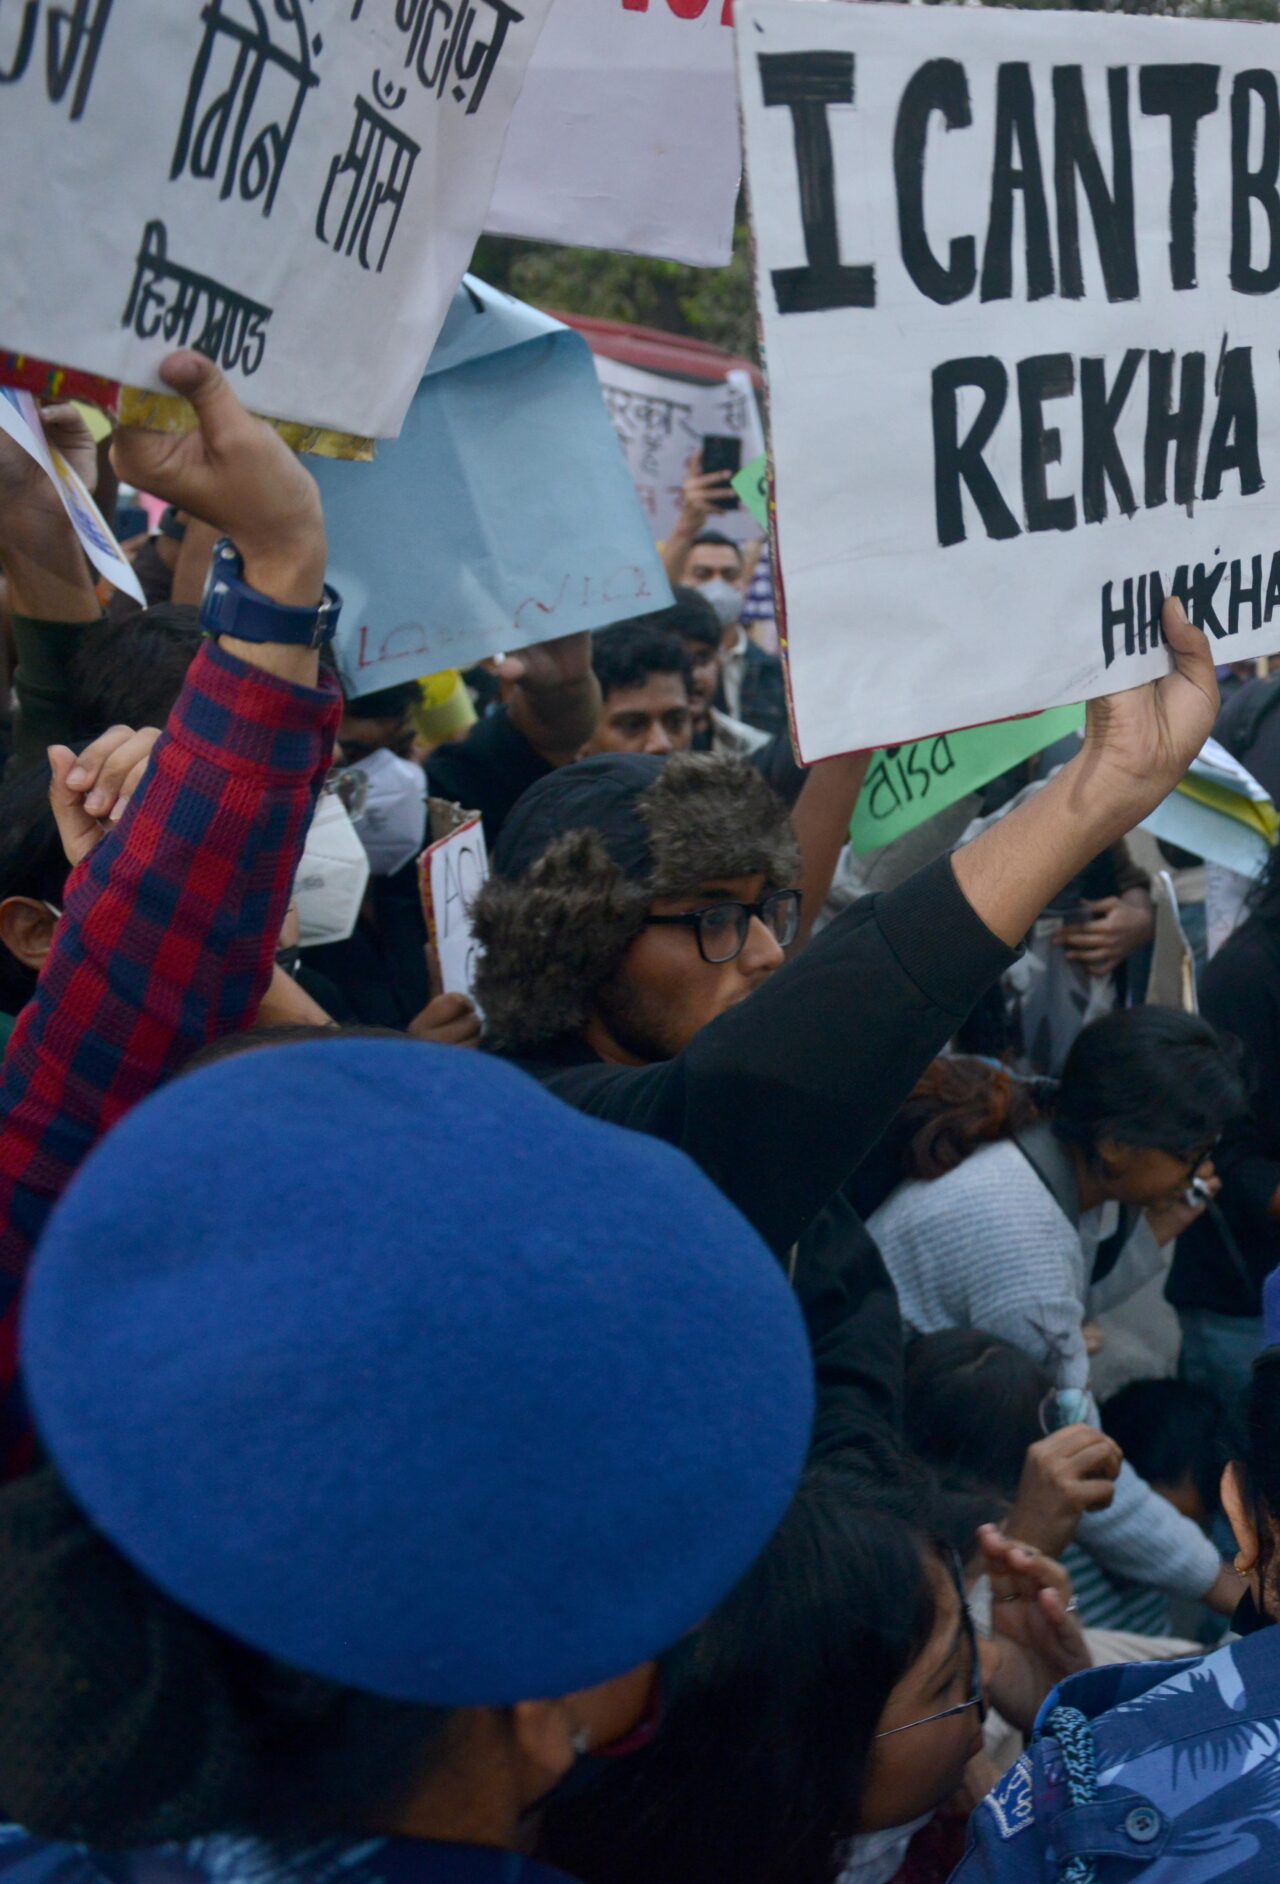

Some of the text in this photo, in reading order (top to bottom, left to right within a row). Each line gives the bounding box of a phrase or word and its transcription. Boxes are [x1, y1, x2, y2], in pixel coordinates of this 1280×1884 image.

[757, 50, 877, 315] I
[893, 57, 1222, 306] CANT
[931, 331, 1266, 549] REKHA
